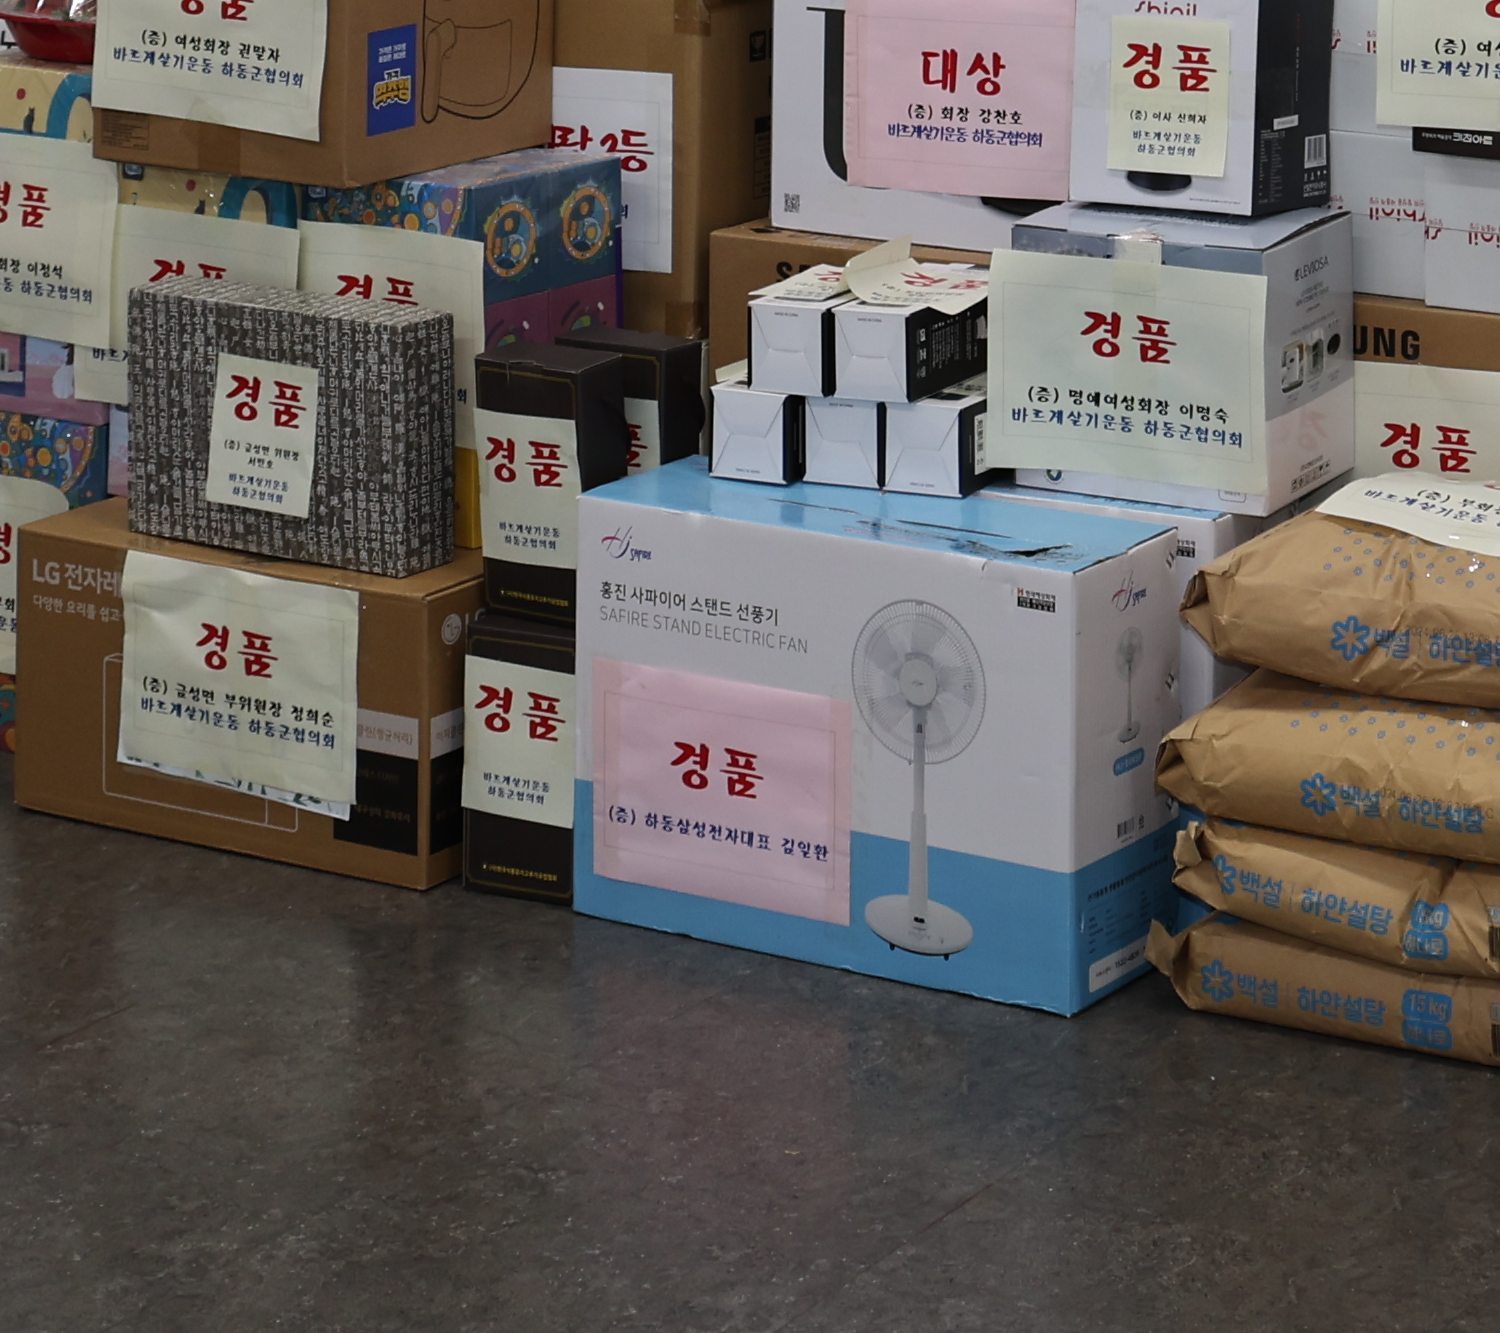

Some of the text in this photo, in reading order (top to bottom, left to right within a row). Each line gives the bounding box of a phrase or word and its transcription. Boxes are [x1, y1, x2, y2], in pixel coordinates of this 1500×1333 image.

[113, 46, 304, 88] 바르게살기운동 하동군협의회
[141, 29, 280, 63] (증) 여성회장 권말자
[1123, 43, 1217, 92] 경품
[1435, 38, 1466, 55] (증)
[921, 49, 1006, 96] 대상
[888, 123, 1043, 147] 바르게살기운동 하동군협의회
[908, 104, 1022, 125] (증) 회장 강찬호
[1132, 130, 1202, 143] 바르게살기운동
[1137, 144, 1195, 157] 하동군협의회
[27, 262, 63, 280] 이정석
[1081, 311, 1177, 364] 경품
[226, 375, 307, 429] 경품
[1028, 386, 1229, 424] (증) 명예여성회장 이명숙
[485, 437, 569, 486] 경품
[1381, 423, 1477, 473] 경품
[33, 558, 61, 584] LG
[33, 595, 62, 613] 다양한
[600, 580, 779, 627] 홍진 사파이어 스탠드 선풍기
[600, 606, 808, 654] SAFIRE STAND ELECTRIC FAN
[143, 677, 334, 727] (증) 금성면 부위원장 정희순
[608, 806, 772, 851] (증) 하동삼성전자대표
[1240, 873, 1393, 935] 백설 하얀설탕
[1236, 975, 1385, 1025] 백설 하얀설탕
